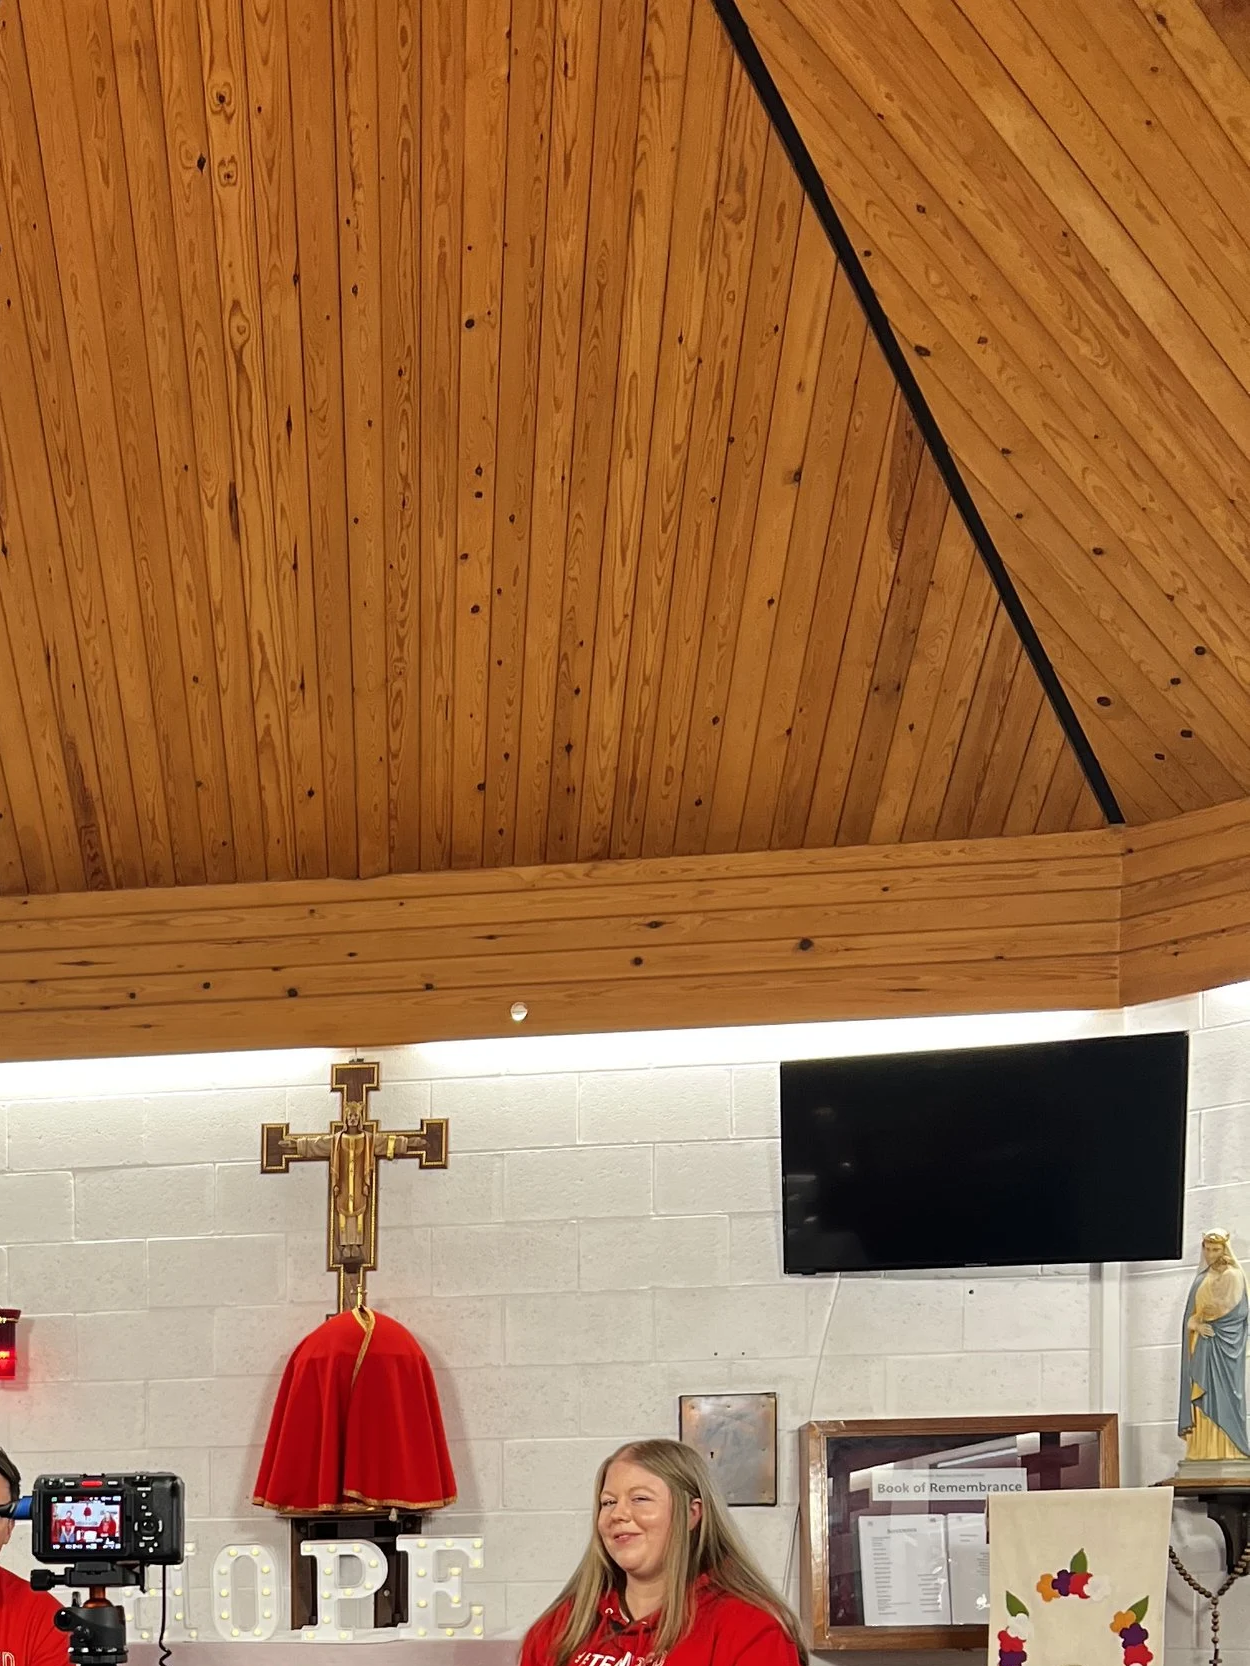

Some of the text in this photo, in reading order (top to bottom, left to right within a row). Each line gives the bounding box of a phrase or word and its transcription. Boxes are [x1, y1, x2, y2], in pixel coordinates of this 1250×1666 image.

[877, 1482, 1024, 1494] Book of Remembrance
